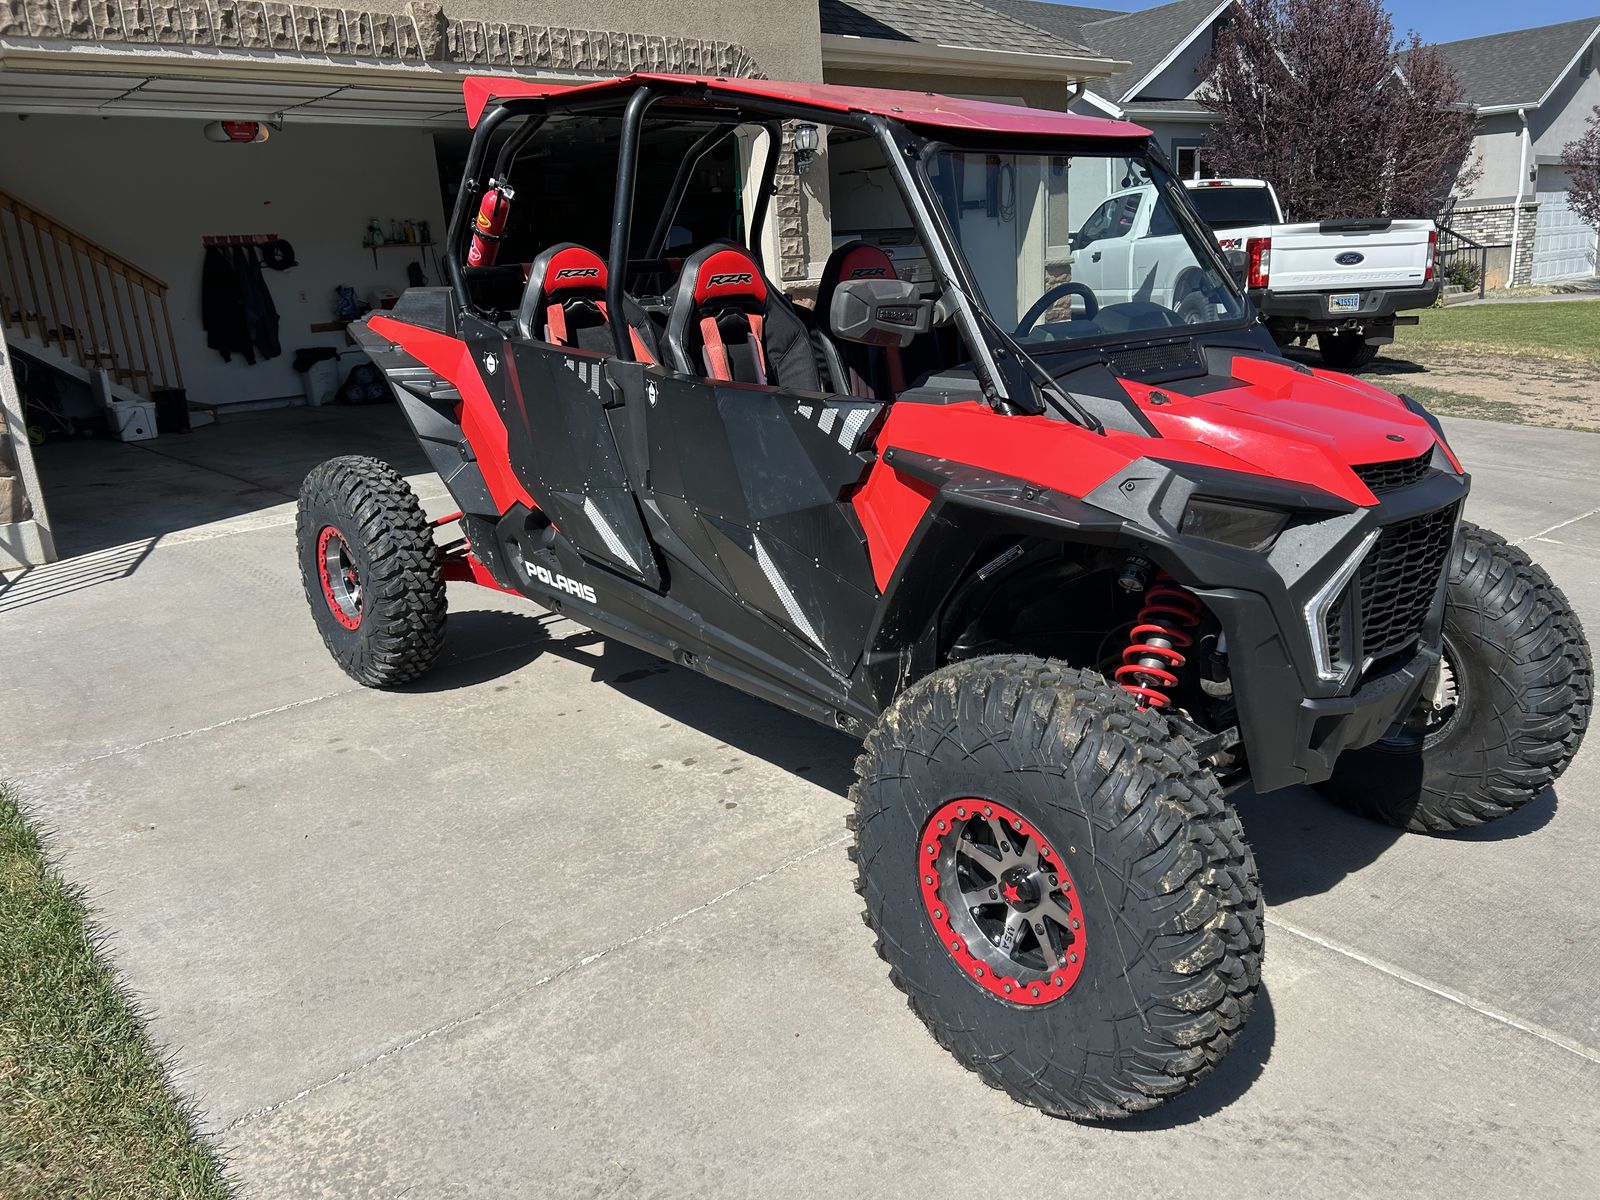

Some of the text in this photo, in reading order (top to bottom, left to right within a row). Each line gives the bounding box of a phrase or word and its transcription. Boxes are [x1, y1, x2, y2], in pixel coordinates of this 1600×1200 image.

[1218, 238, 1243, 249] FX4
[555, 268, 599, 281] RZR
[850, 267, 887, 280] RZR
[1291, 274, 1353, 283] SUPER
[1358, 272, 1403, 281] DUTY
[706, 272, 753, 289] RZR
[524, 560, 597, 604] POLARIS
